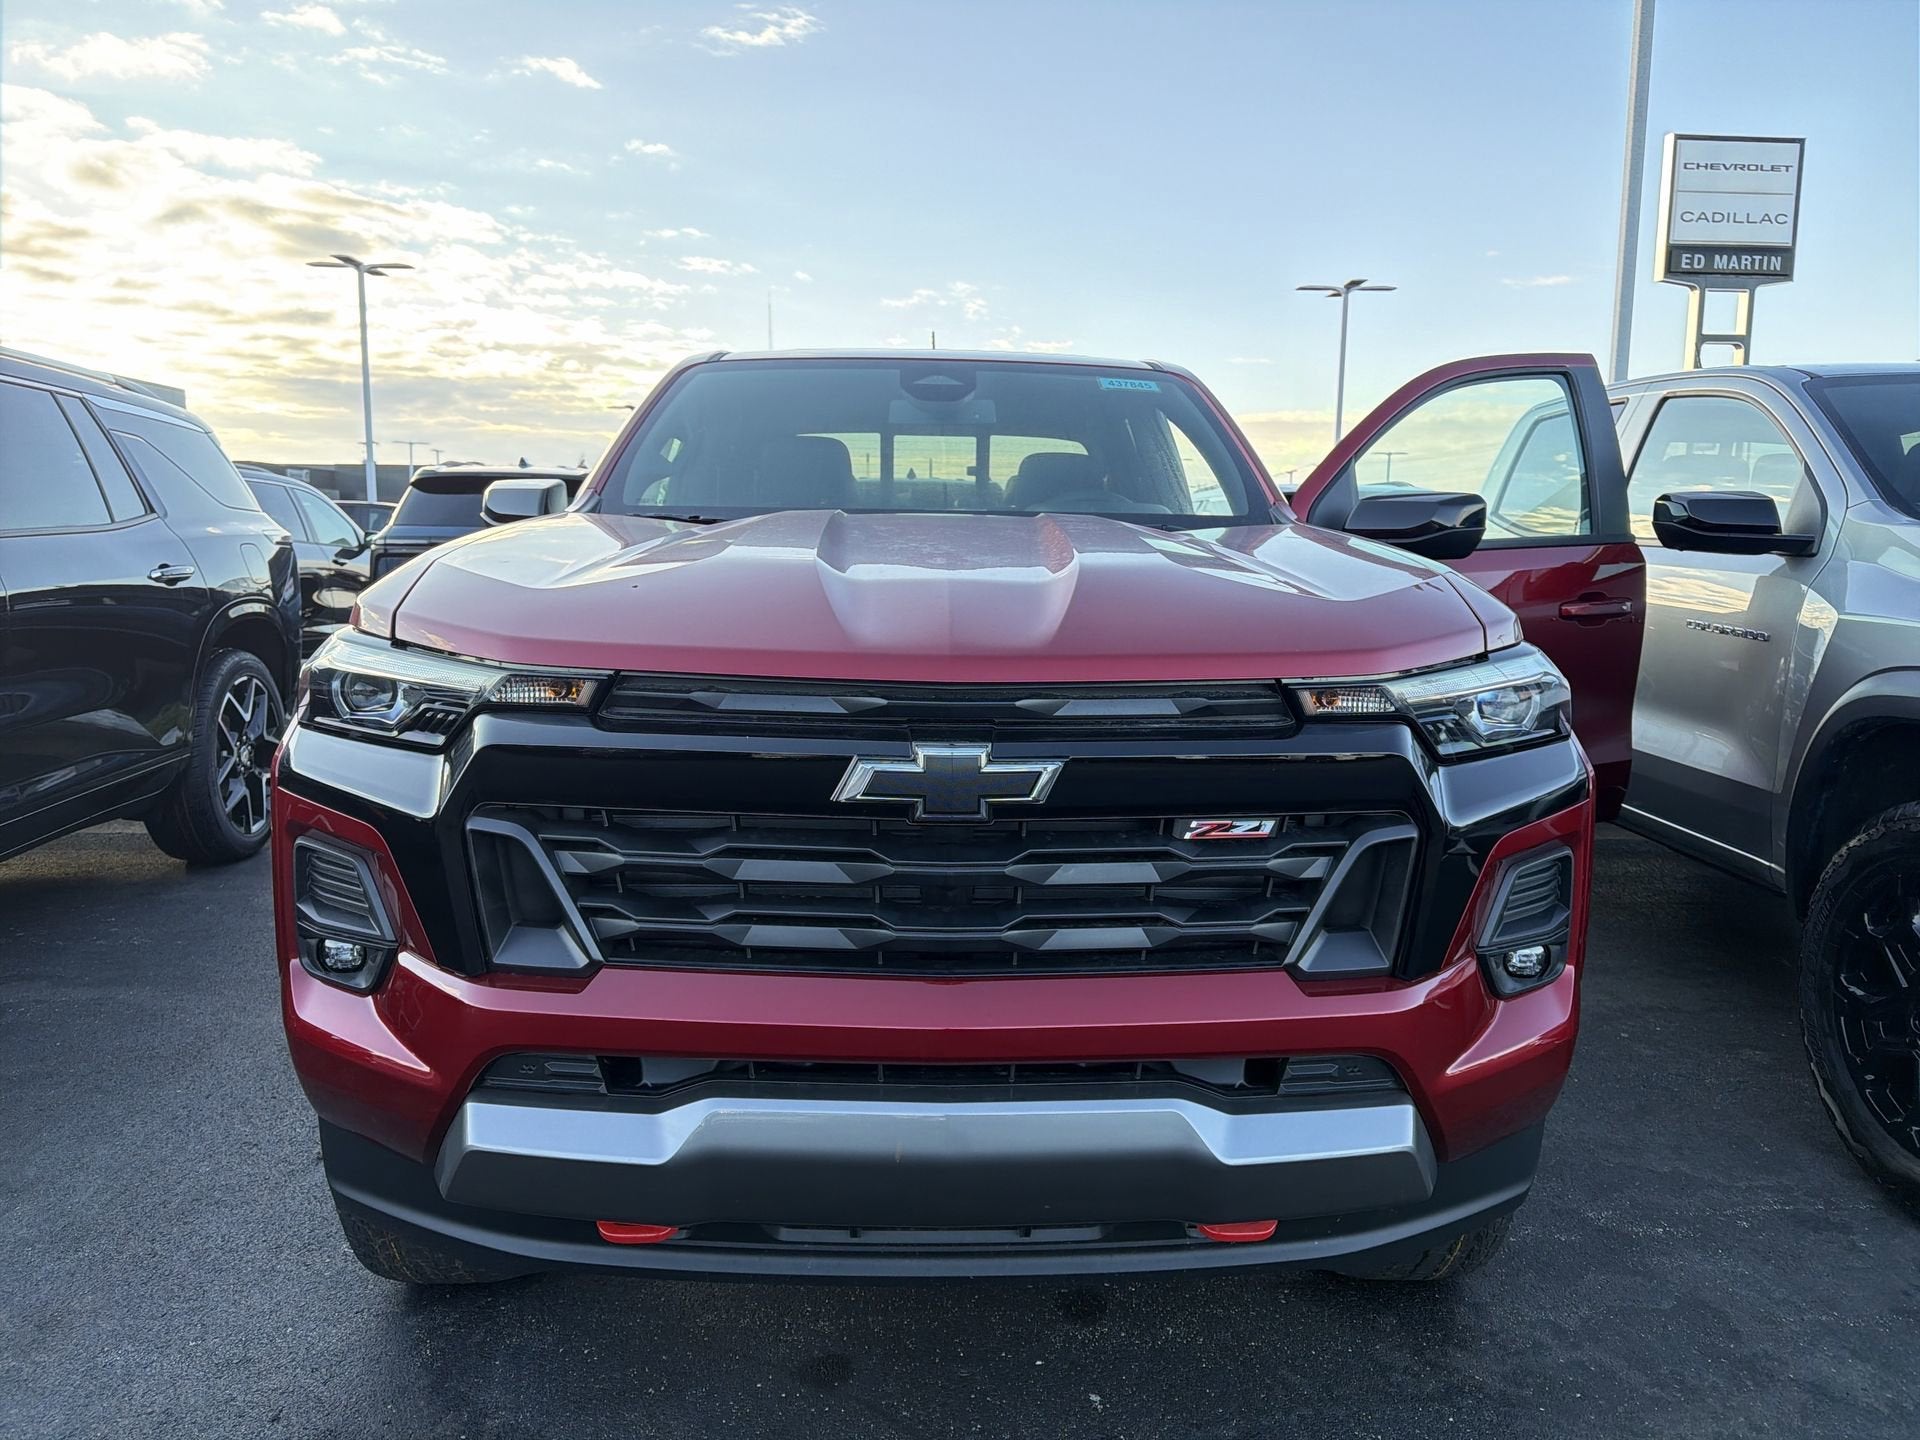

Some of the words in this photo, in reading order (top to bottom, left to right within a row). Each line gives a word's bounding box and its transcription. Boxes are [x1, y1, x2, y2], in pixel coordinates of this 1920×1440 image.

[1683, 162, 1793, 173] CHEVROLET
[1680, 211, 1788, 224] CADILLAC
[1681, 253, 1705, 269] ED
[1713, 254, 1782, 271] MARTIN
[1183, 820, 1276, 840] Z71
